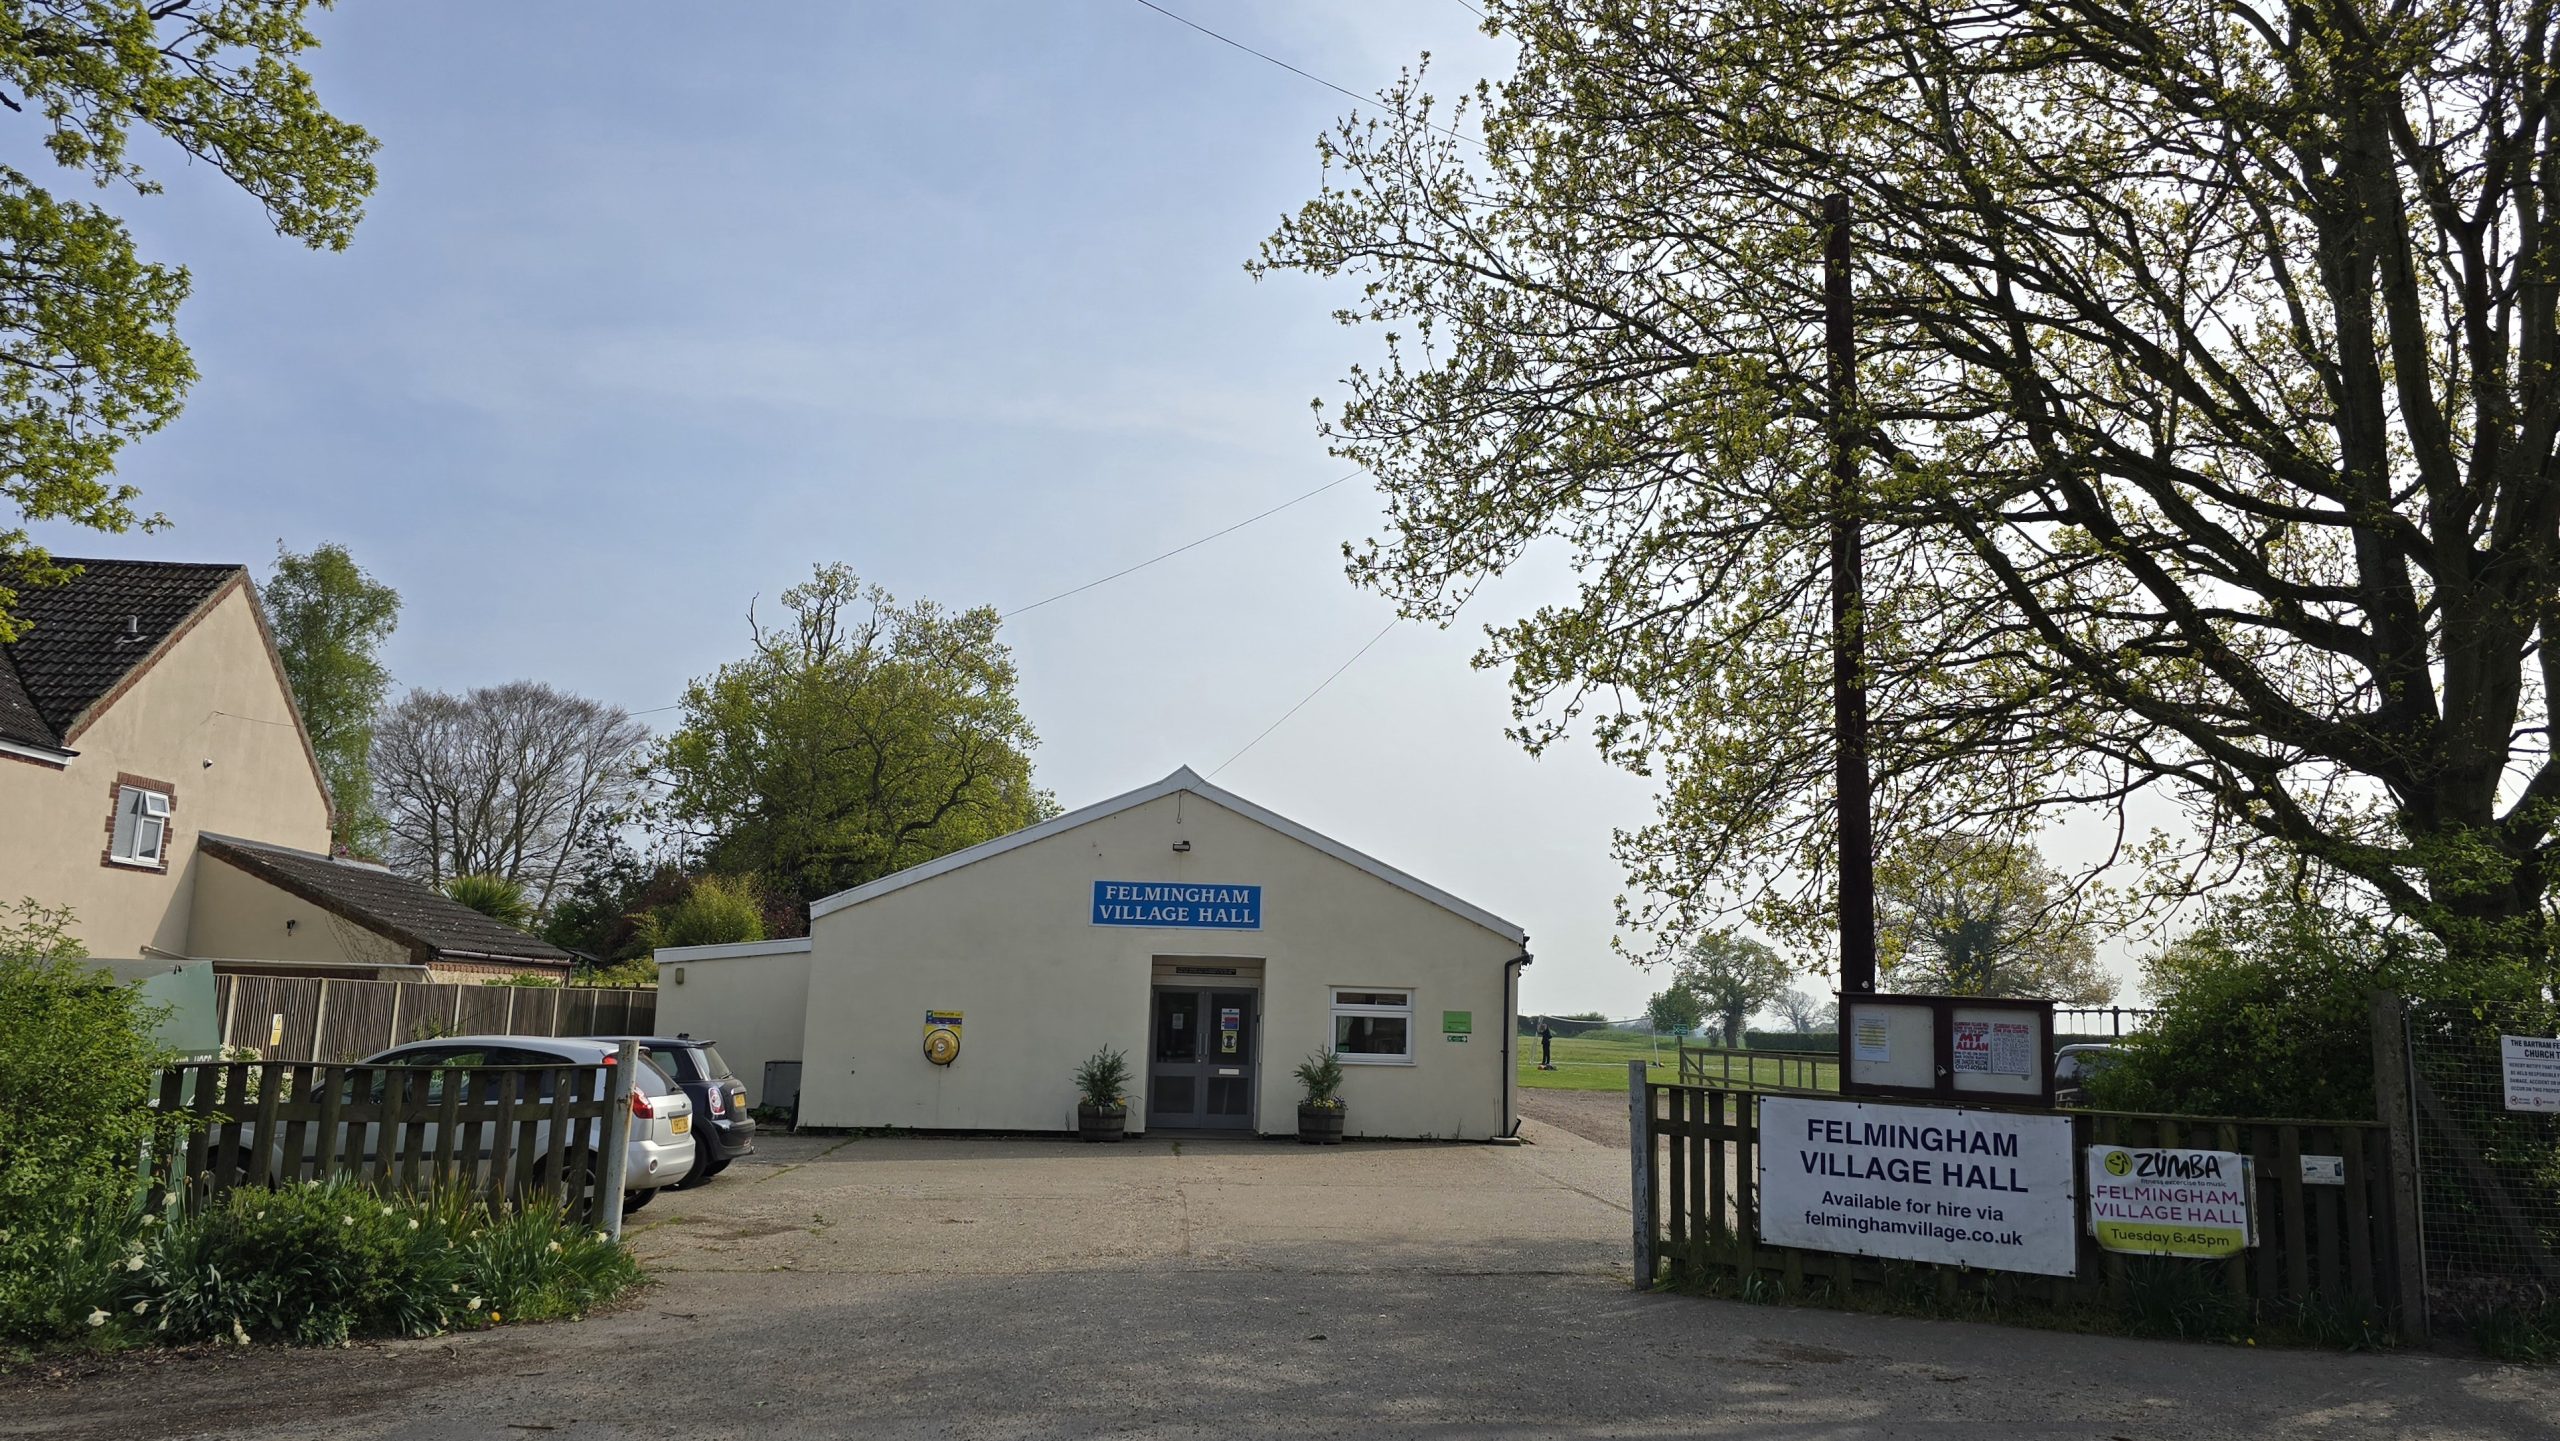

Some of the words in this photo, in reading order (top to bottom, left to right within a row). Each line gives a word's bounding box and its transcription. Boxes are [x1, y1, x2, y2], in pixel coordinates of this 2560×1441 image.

[1105, 885, 1250, 904] FELMINGHAM
[1099, 904, 1190, 922] VILLAGE
[1198, 907, 1255, 923] HALL
[1956, 1042, 1989, 1051] ALLAN
[1959, 1033, 1984, 1042] MT
[2524, 1049, 2555, 1059] CHURCH
[1807, 1118, 2019, 1158] FELMINGHAM
[1800, 1150, 1932, 1185] VILLAGE
[1943, 1162, 2029, 1193] HALL
[2134, 1150, 2222, 1179] ZUMBA
[2097, 1185, 2239, 1205] FELMINGHAM
[1821, 1190, 1901, 1212] Available
[1906, 1197, 1932, 1214] for
[1936, 1201, 1972, 1219] hire
[1977, 1205, 2004, 1222] via
[2095, 1202, 2182, 1221] VILLAGE
[2188, 1208, 2244, 1224] HALL
[1804, 1210, 2024, 1246] felminghamvillage.co.uk
[2111, 1228, 2170, 1244] Tuesday
[2173, 1233, 2230, 1248] 6:45pm
